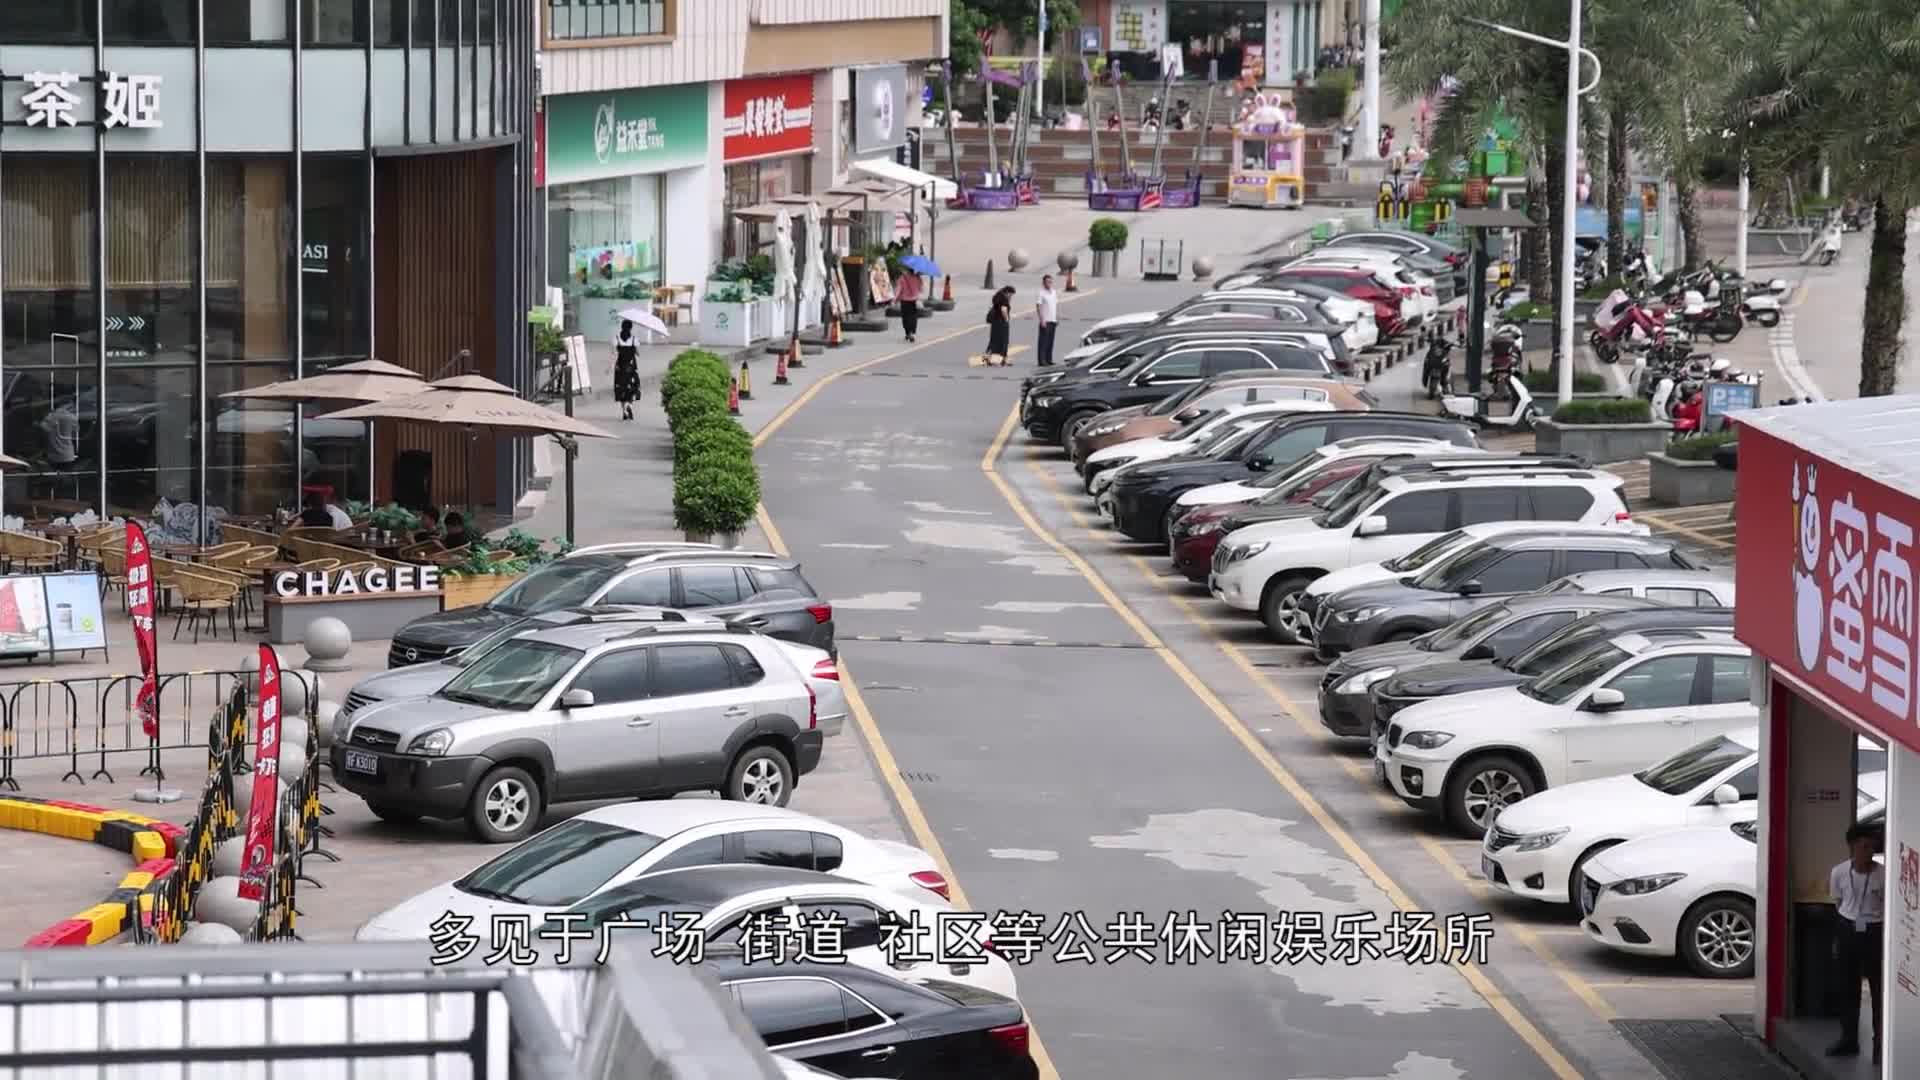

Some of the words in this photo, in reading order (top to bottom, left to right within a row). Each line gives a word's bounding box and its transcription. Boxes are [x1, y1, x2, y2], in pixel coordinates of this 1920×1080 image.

[22, 71, 163, 128] 茶姬
[276, 565, 439, 597] CHAGEE
[1827, 492, 1920, 727] 蜜雪
